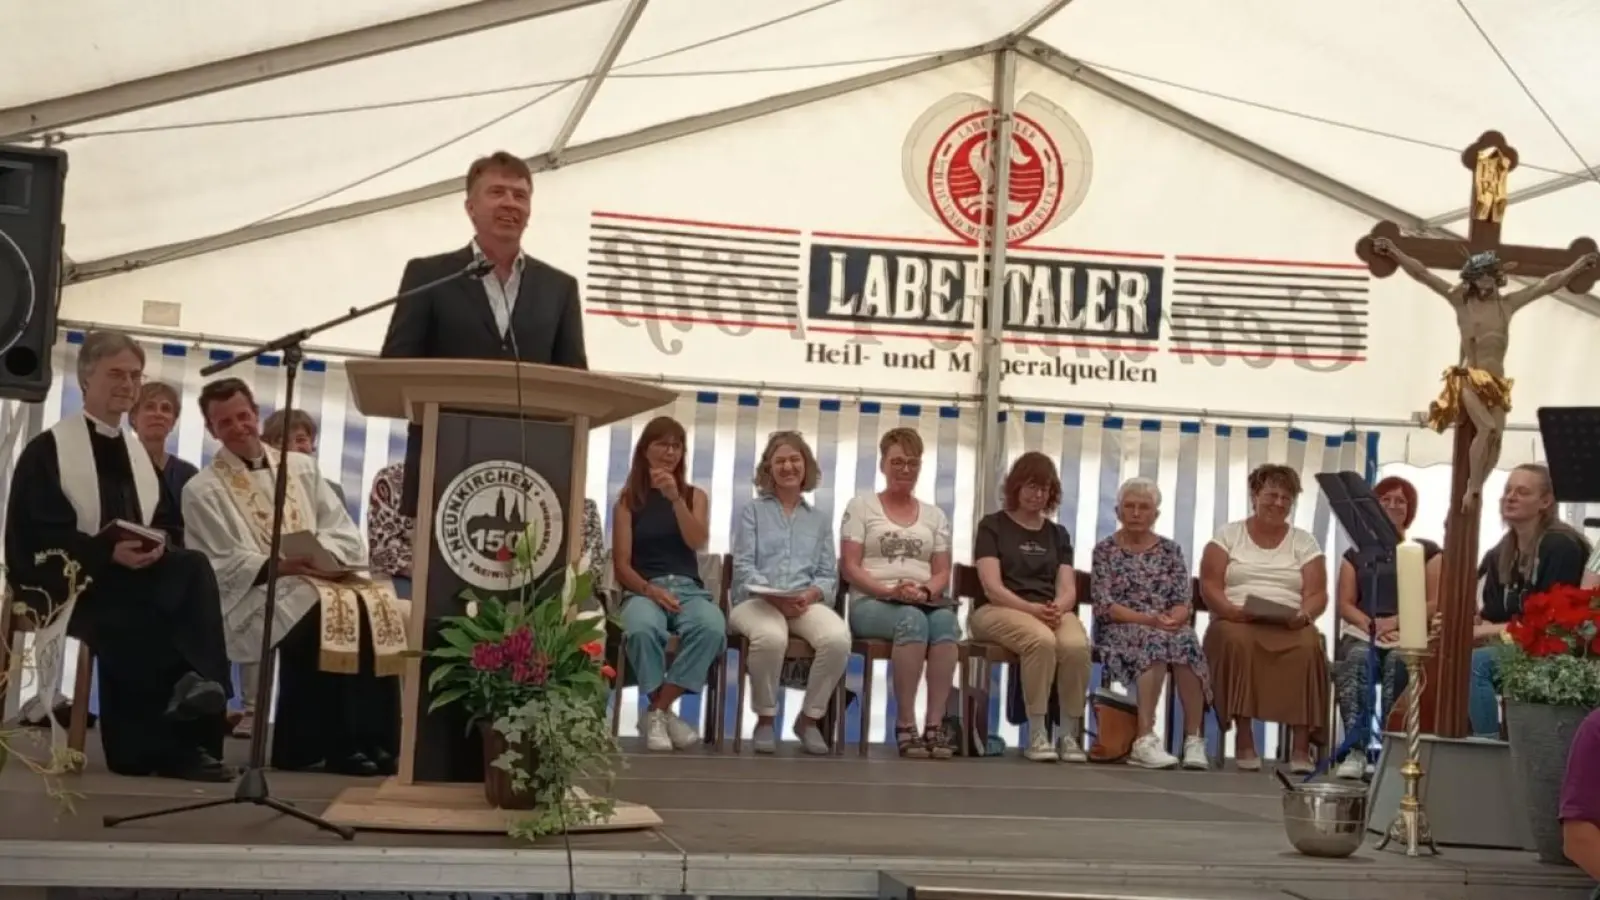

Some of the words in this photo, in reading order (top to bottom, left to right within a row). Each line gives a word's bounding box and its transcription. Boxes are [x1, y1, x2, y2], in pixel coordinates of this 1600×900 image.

[805, 342, 872, 367] Heil-
[882, 346, 936, 371] und
[948, 351, 1158, 385] Mneralquellen
[444, 470, 534, 552] NEUNKIRCHEN
